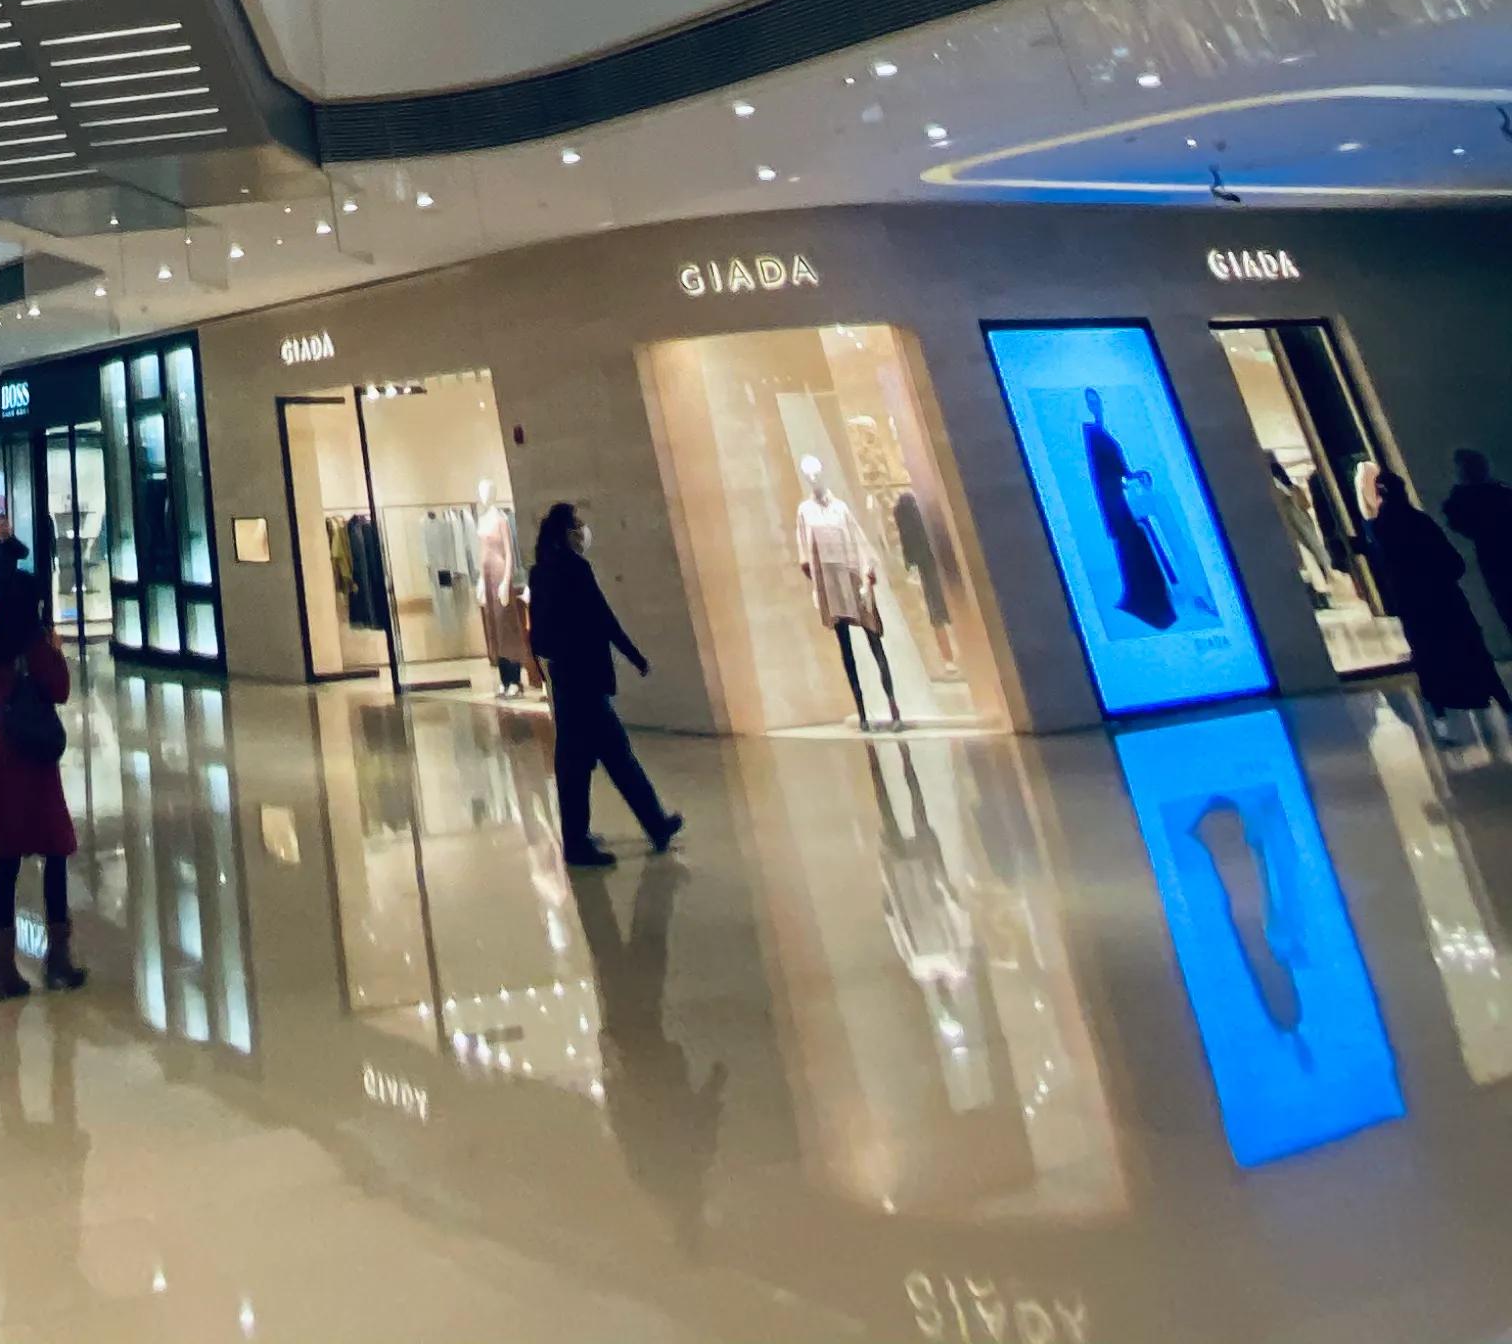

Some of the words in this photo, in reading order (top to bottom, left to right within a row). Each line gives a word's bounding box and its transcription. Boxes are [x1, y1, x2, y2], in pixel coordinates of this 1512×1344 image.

[678, 255, 820, 297] GIADA
[1207, 249, 1300, 280] GIADA
[281, 330, 335, 366] GIADA
[1, 382, 30, 410] BOSS
